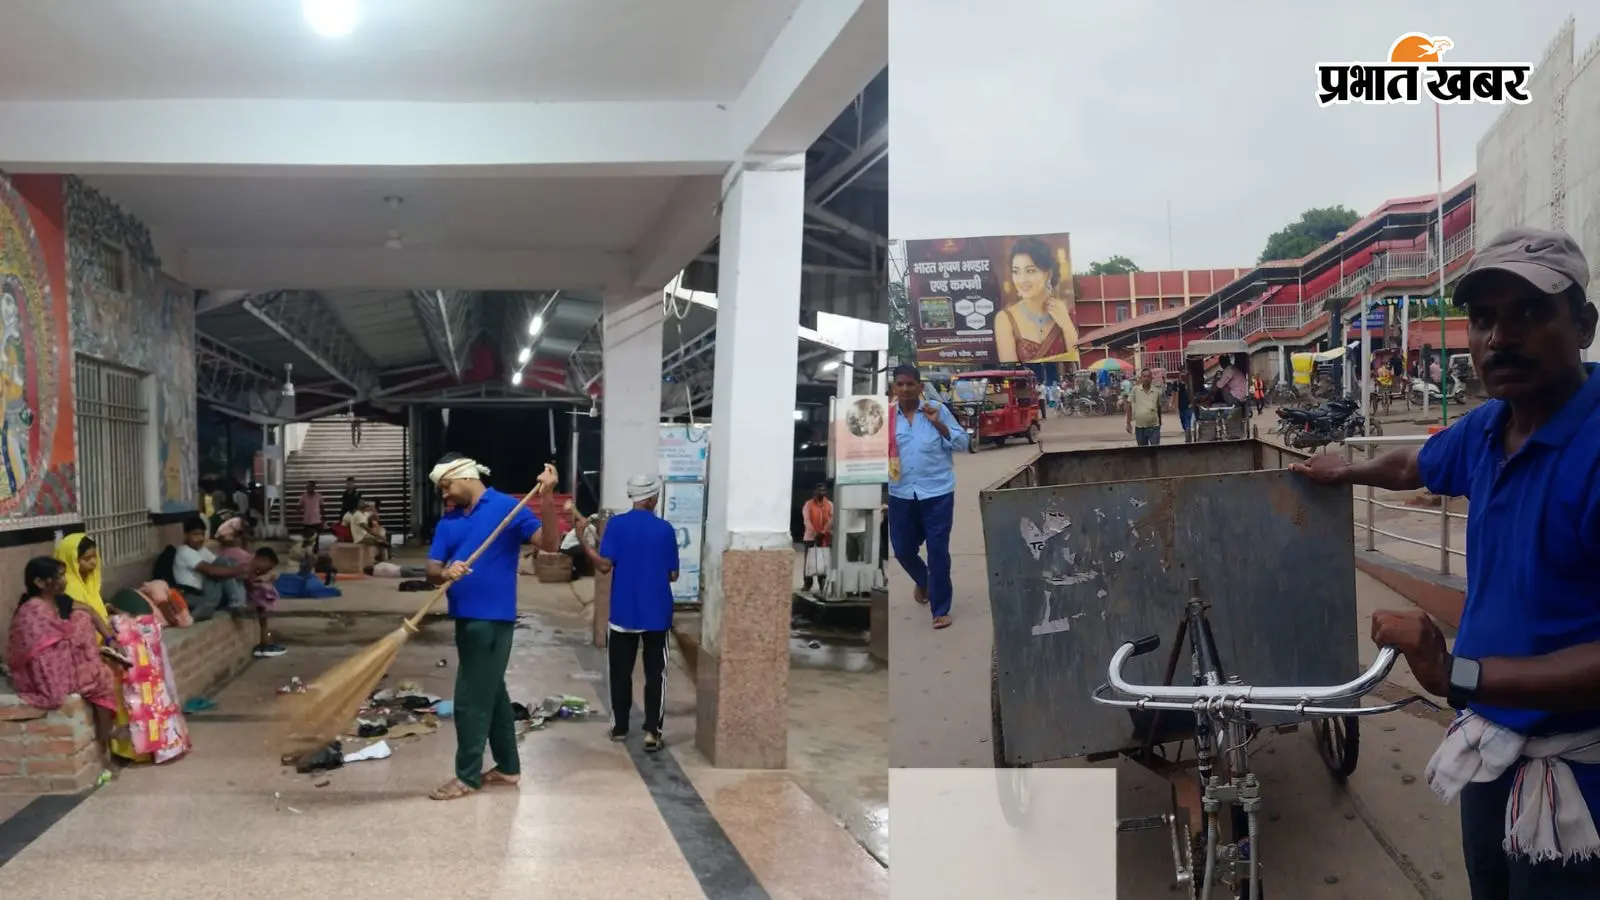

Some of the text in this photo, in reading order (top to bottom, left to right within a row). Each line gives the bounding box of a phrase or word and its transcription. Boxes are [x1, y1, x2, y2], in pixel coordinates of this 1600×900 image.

[913, 262, 937, 274] भारत
[962, 259, 990, 272] भण्डार
[949, 274, 982, 290] कम्पनी
